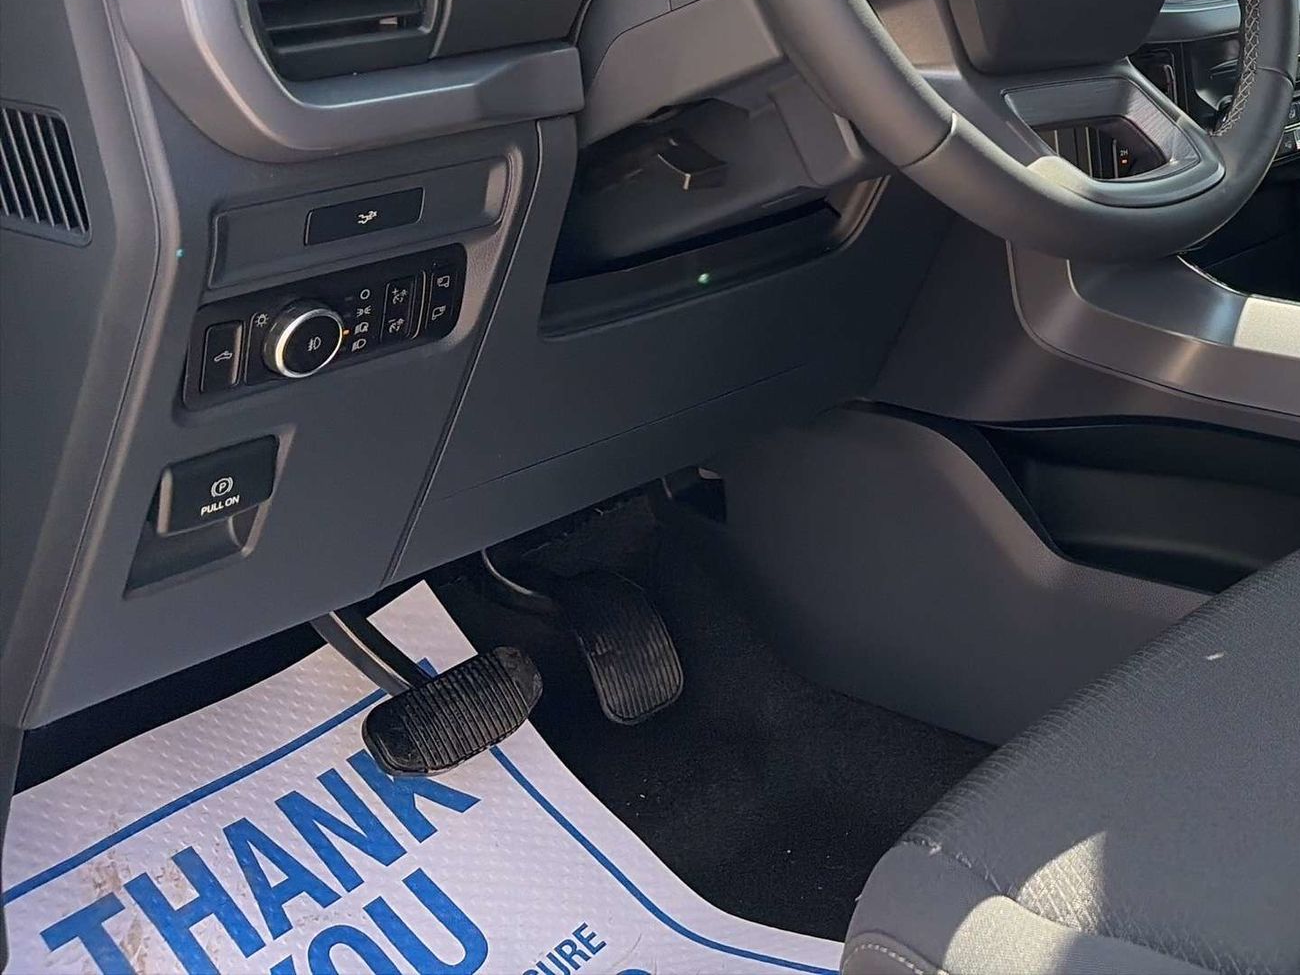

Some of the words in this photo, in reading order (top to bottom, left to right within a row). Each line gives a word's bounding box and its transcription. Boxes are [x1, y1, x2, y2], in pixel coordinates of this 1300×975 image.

[201, 501, 224, 516] PULL
[225, 495, 240, 507] ON
[40, 748, 481, 975] THANK
[522, 922, 607, 975] URE
